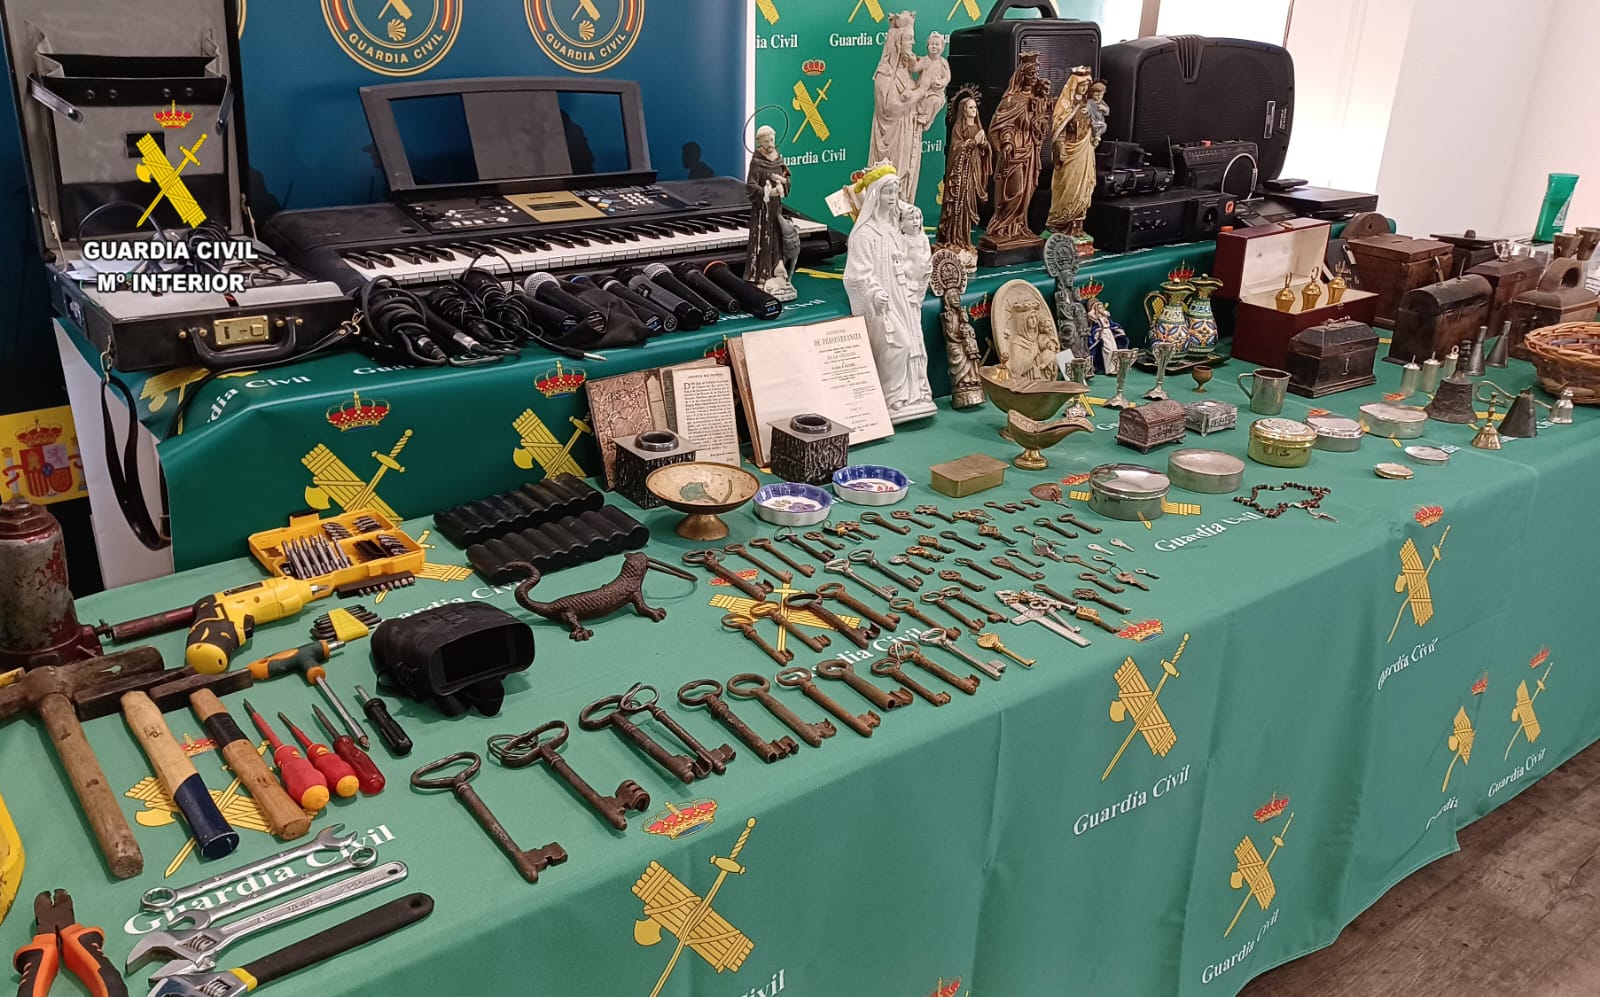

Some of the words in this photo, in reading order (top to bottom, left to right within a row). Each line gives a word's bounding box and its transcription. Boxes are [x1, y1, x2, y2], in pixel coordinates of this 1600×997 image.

[348, 33, 409, 64] GUARDIA
[413, 31, 444, 60] CIVIL
[545, 32, 596, 62] GUARDIA
[599, 32, 627, 58] CIVIL
[770, 34, 798, 49] Civil
[829, 33, 873, 47] Guardia
[783, 153, 819, 167] uardia
[821, 148, 847, 163] Civil
[245, 375, 312, 389] Civil
[1154, 521, 1227, 552] Guardia
[1073, 790, 1147, 836] Guardia
[1152, 764, 1190, 798] Civil
[1201, 940, 1256, 984] Guardia
